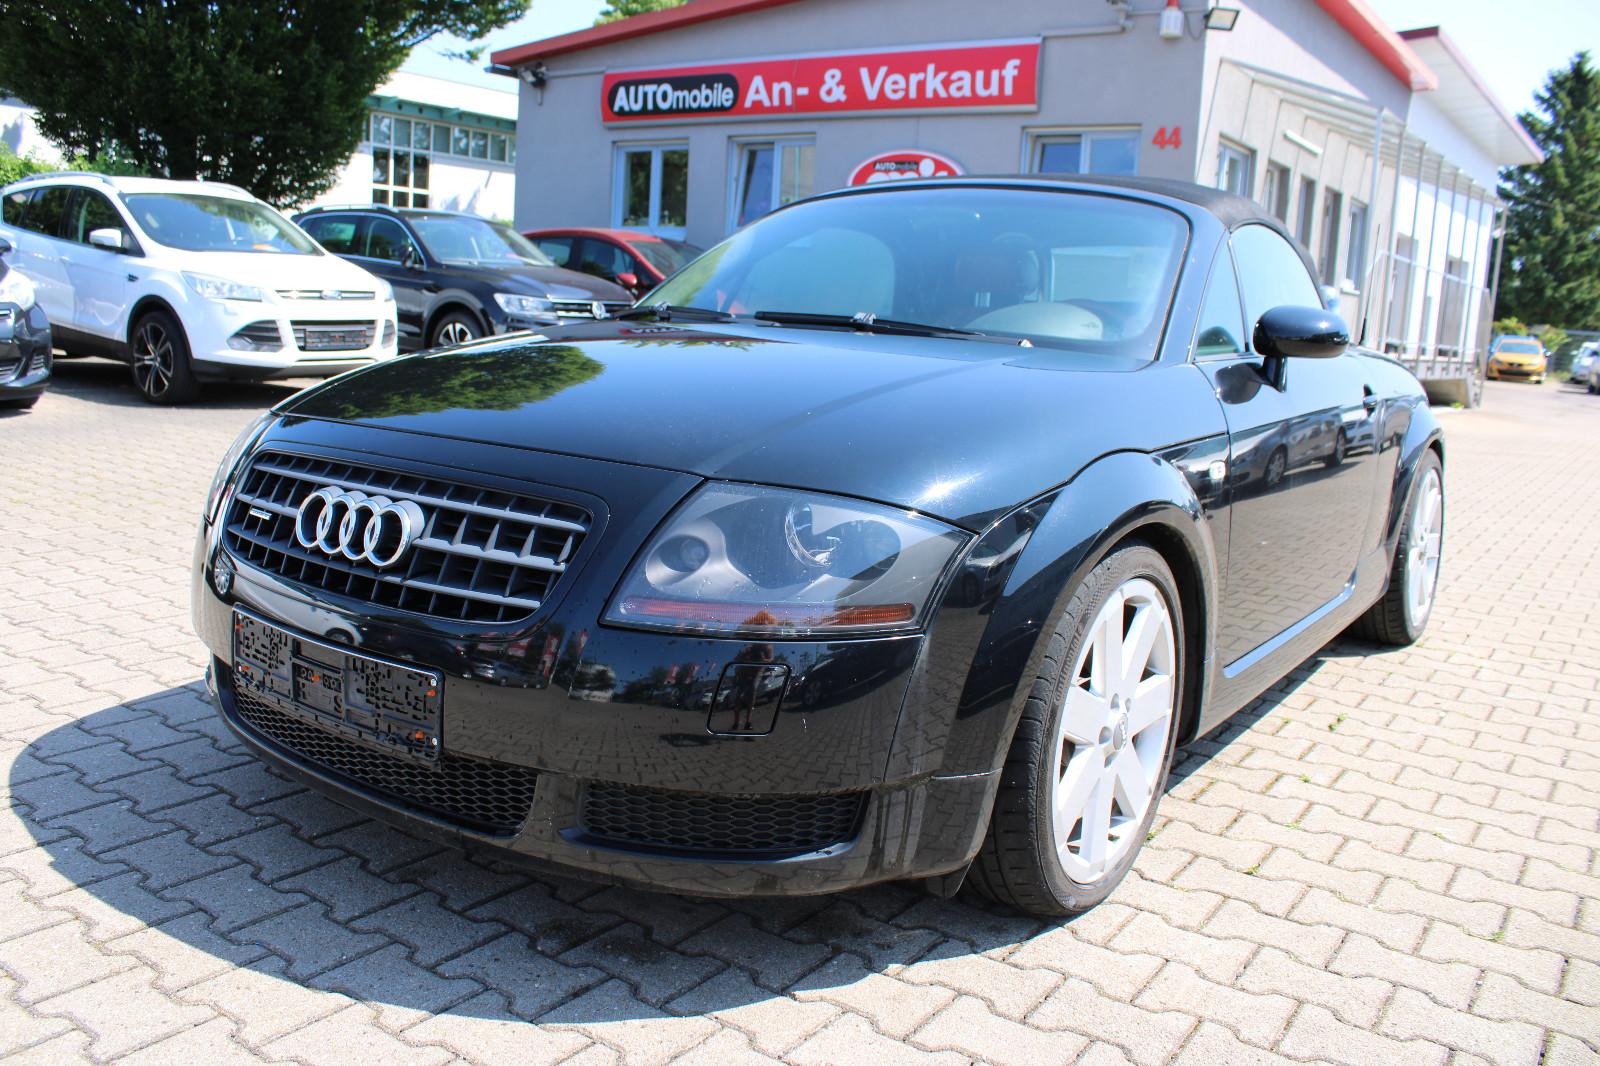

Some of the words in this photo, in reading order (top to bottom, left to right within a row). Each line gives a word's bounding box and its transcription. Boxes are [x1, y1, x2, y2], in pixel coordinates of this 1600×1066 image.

[613, 82, 734, 112] AUTOmobile
[744, 74, 809, 108] An-
[819, 68, 847, 103] &
[859, 58, 1021, 101] Verkauf
[1151, 127, 1182, 150] 44
